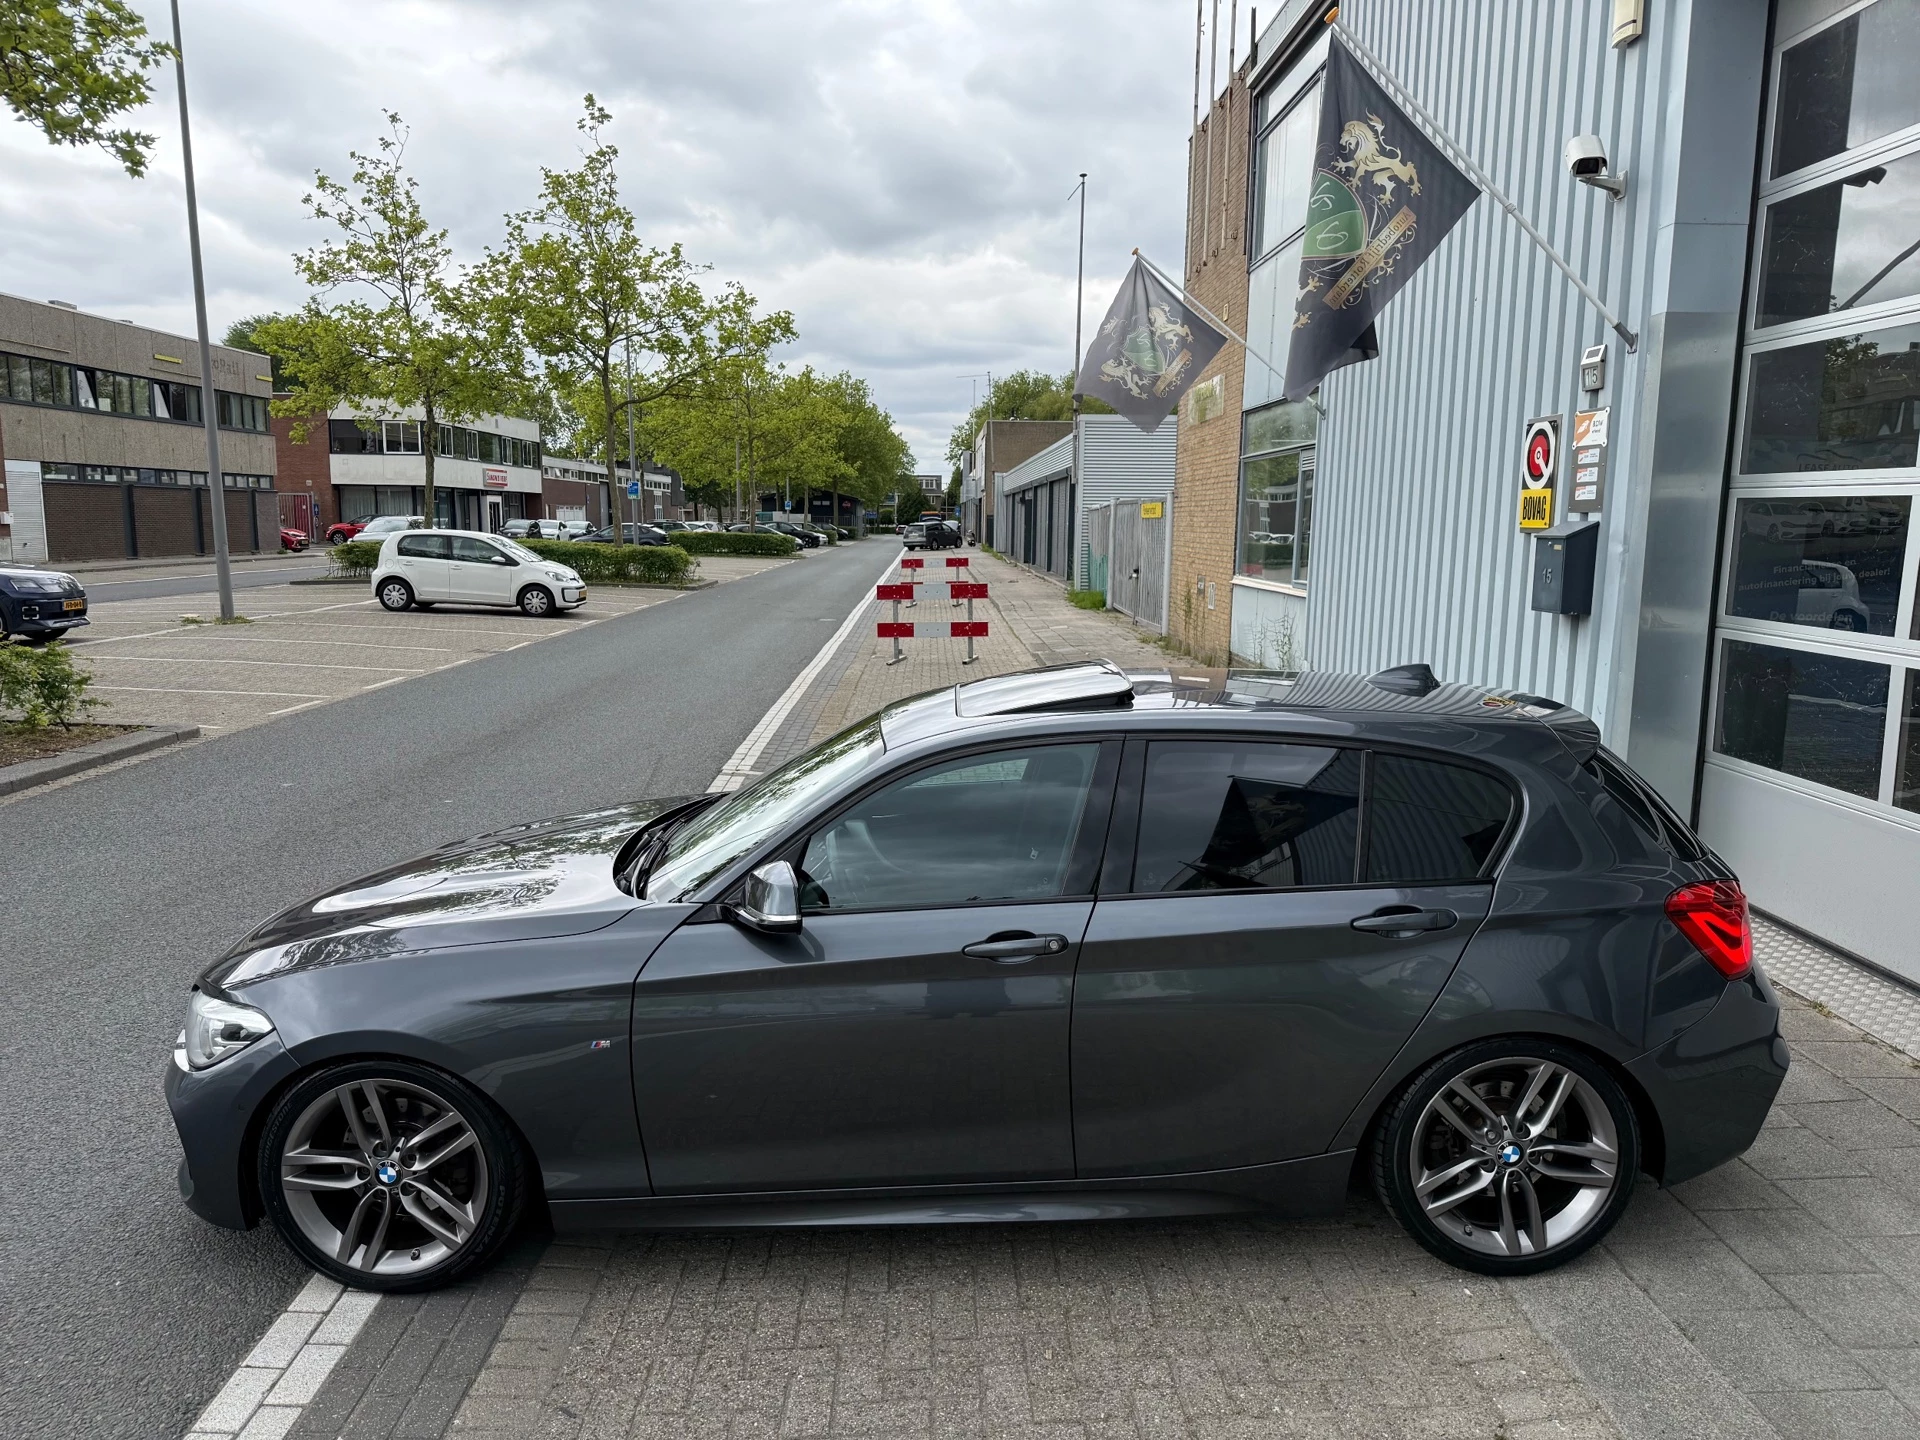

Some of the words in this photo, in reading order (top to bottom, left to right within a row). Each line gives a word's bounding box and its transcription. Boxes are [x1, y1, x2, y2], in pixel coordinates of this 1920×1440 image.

[1586, 368, 1598, 385] 15
[1798, 463, 1830, 472] LEASE
[1522, 495, 1546, 520] BOVAG
[1773, 562, 1816, 574] Financial
[1542, 568, 1552, 584] 15
[1738, 576, 1817, 592] autofinanciering
[1819, 573, 1833, 584] bij
[1858, 567, 1891, 578] dealer!
[1769, 610, 1787, 621] De
[1790, 611, 1852, 622] voordelen
[376, 1160, 400, 1171] BMW
